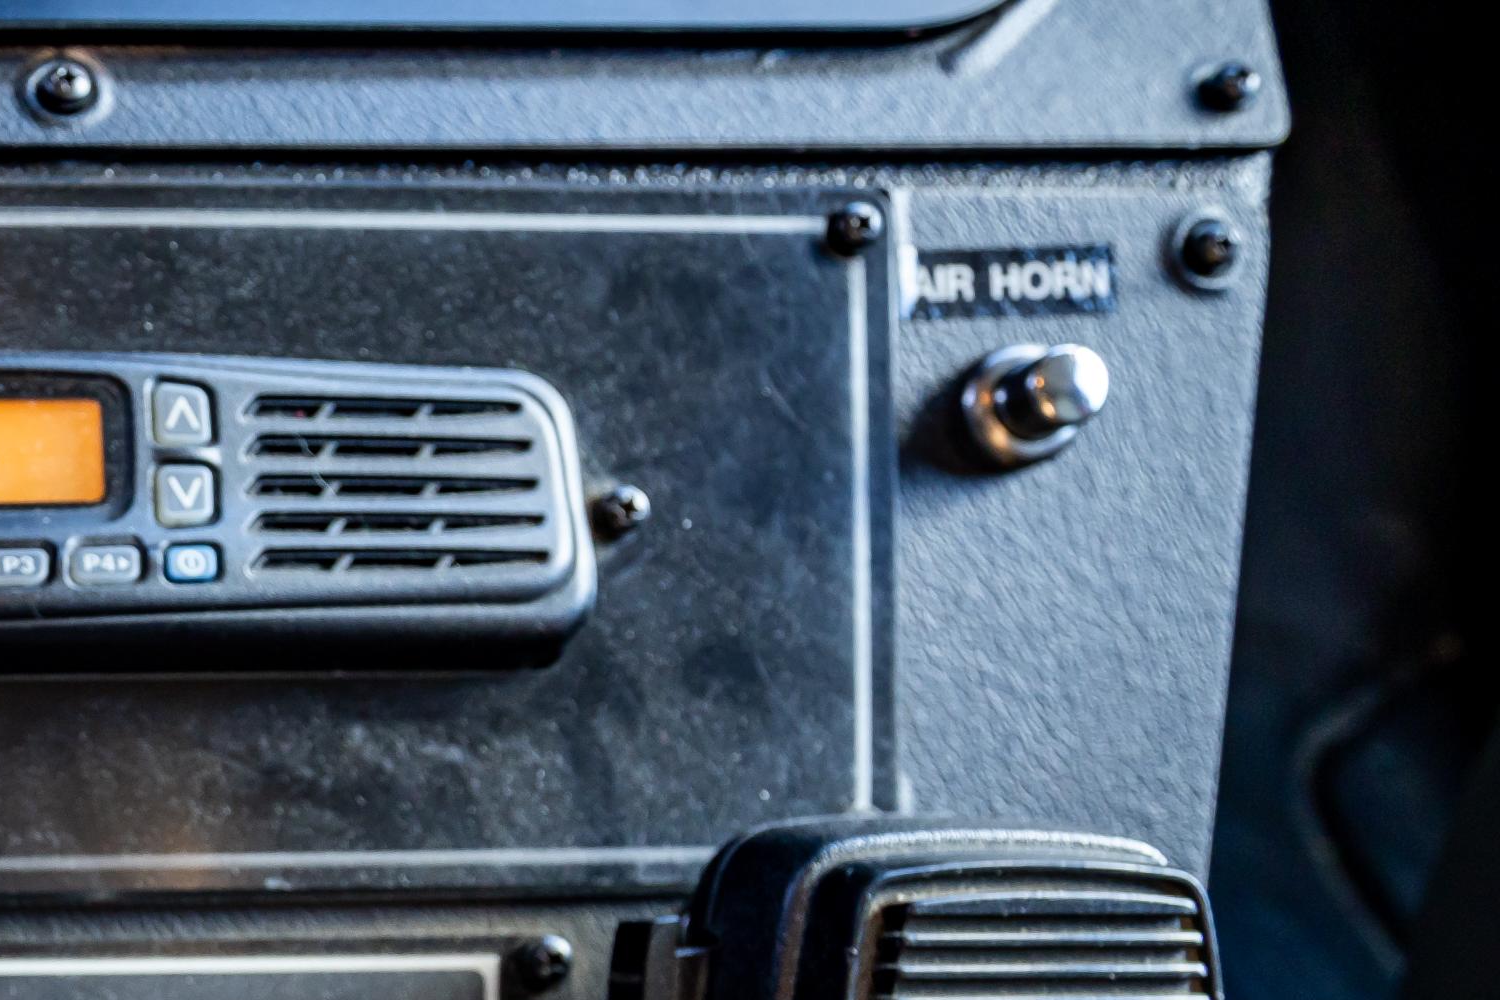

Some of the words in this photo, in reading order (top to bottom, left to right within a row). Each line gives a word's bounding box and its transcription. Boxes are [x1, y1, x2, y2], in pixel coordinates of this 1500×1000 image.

[914, 263, 976, 302] AIR
[989, 259, 1110, 301] HORN
[3, 555, 36, 575] P3
